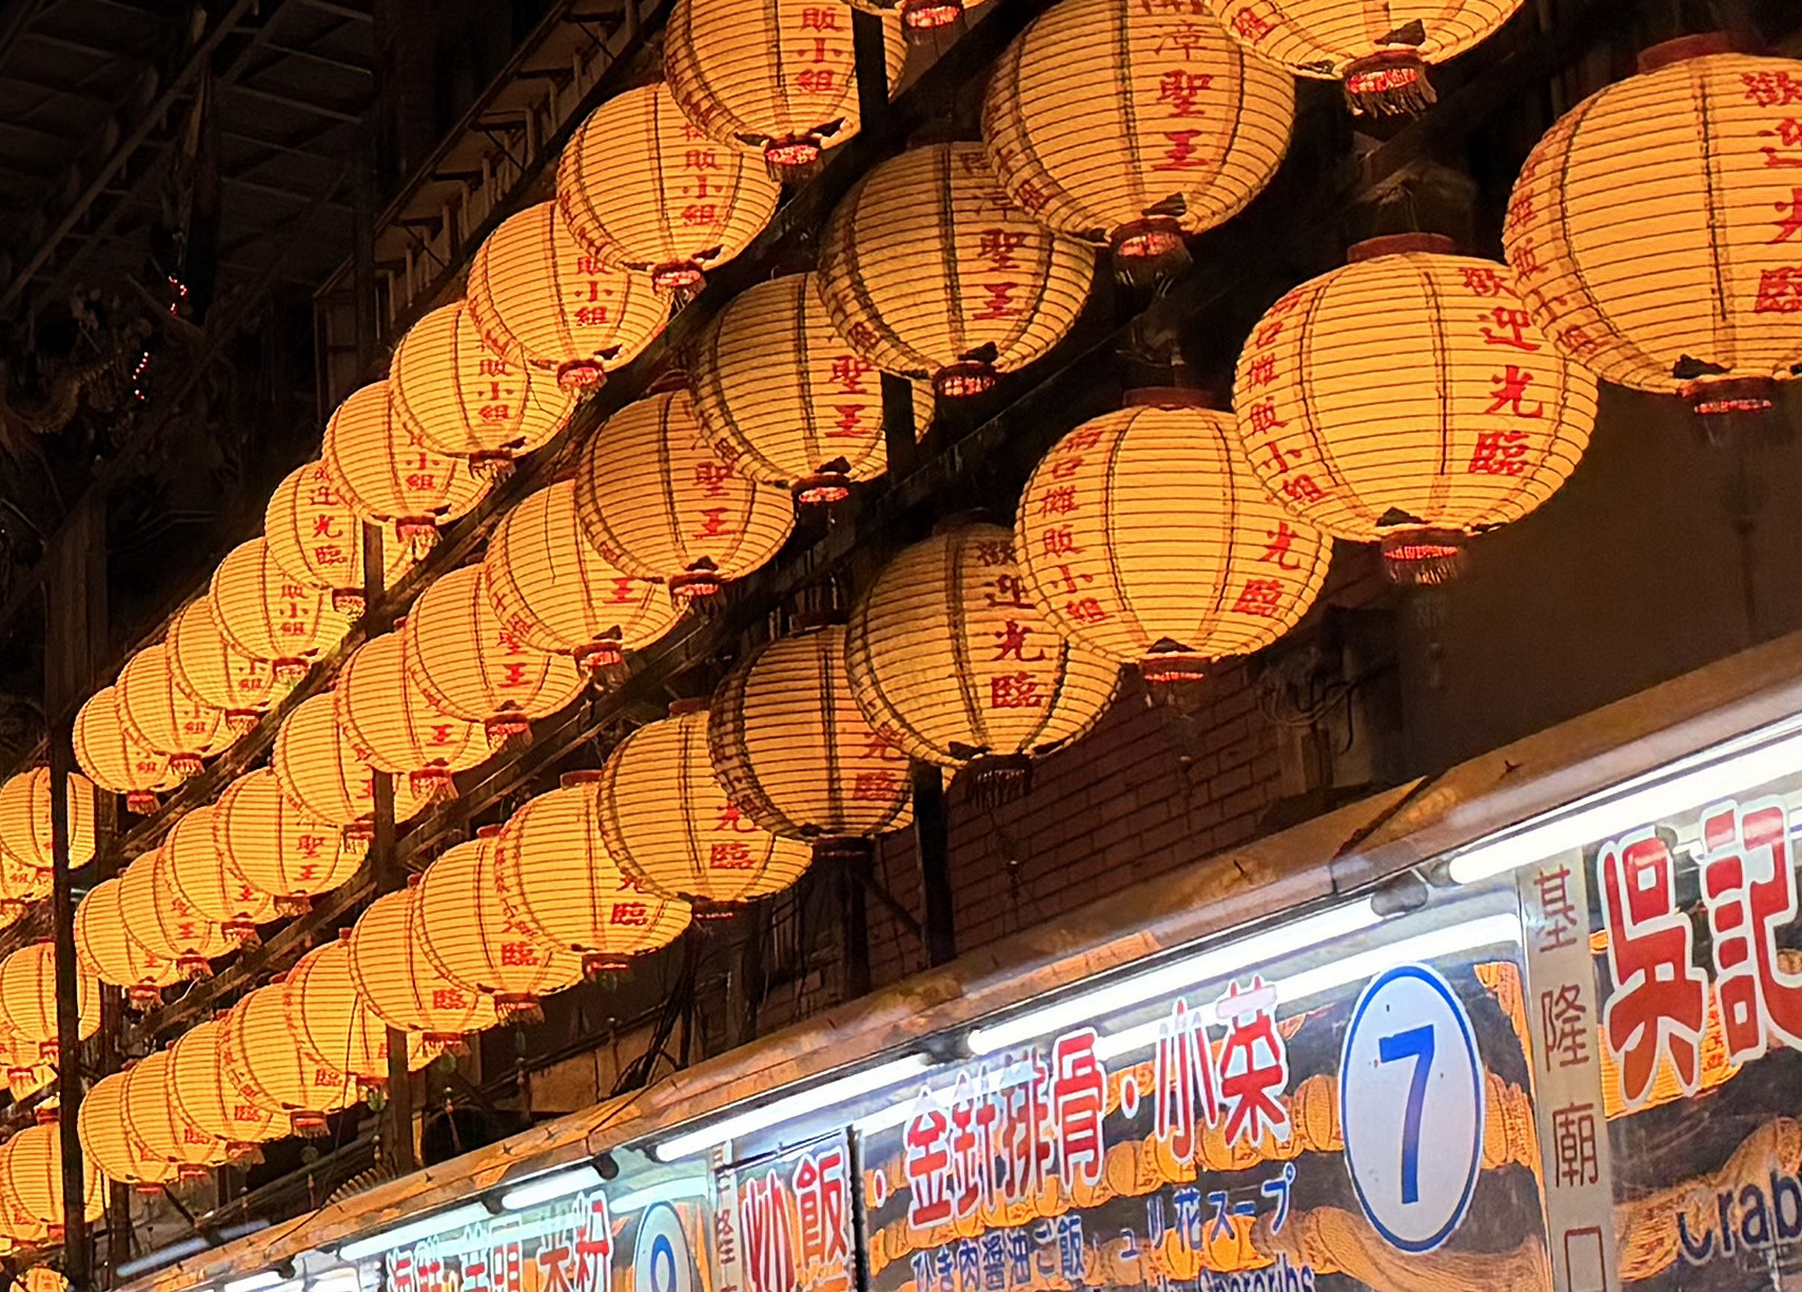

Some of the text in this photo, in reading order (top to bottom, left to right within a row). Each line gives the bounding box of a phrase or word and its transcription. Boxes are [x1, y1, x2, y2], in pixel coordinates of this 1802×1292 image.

[1597, 794, 1802, 1106] 吳記
[901, 975, 1291, 1233] 金針排骨 小菜
[1377, 1023, 1438, 1205] 7
